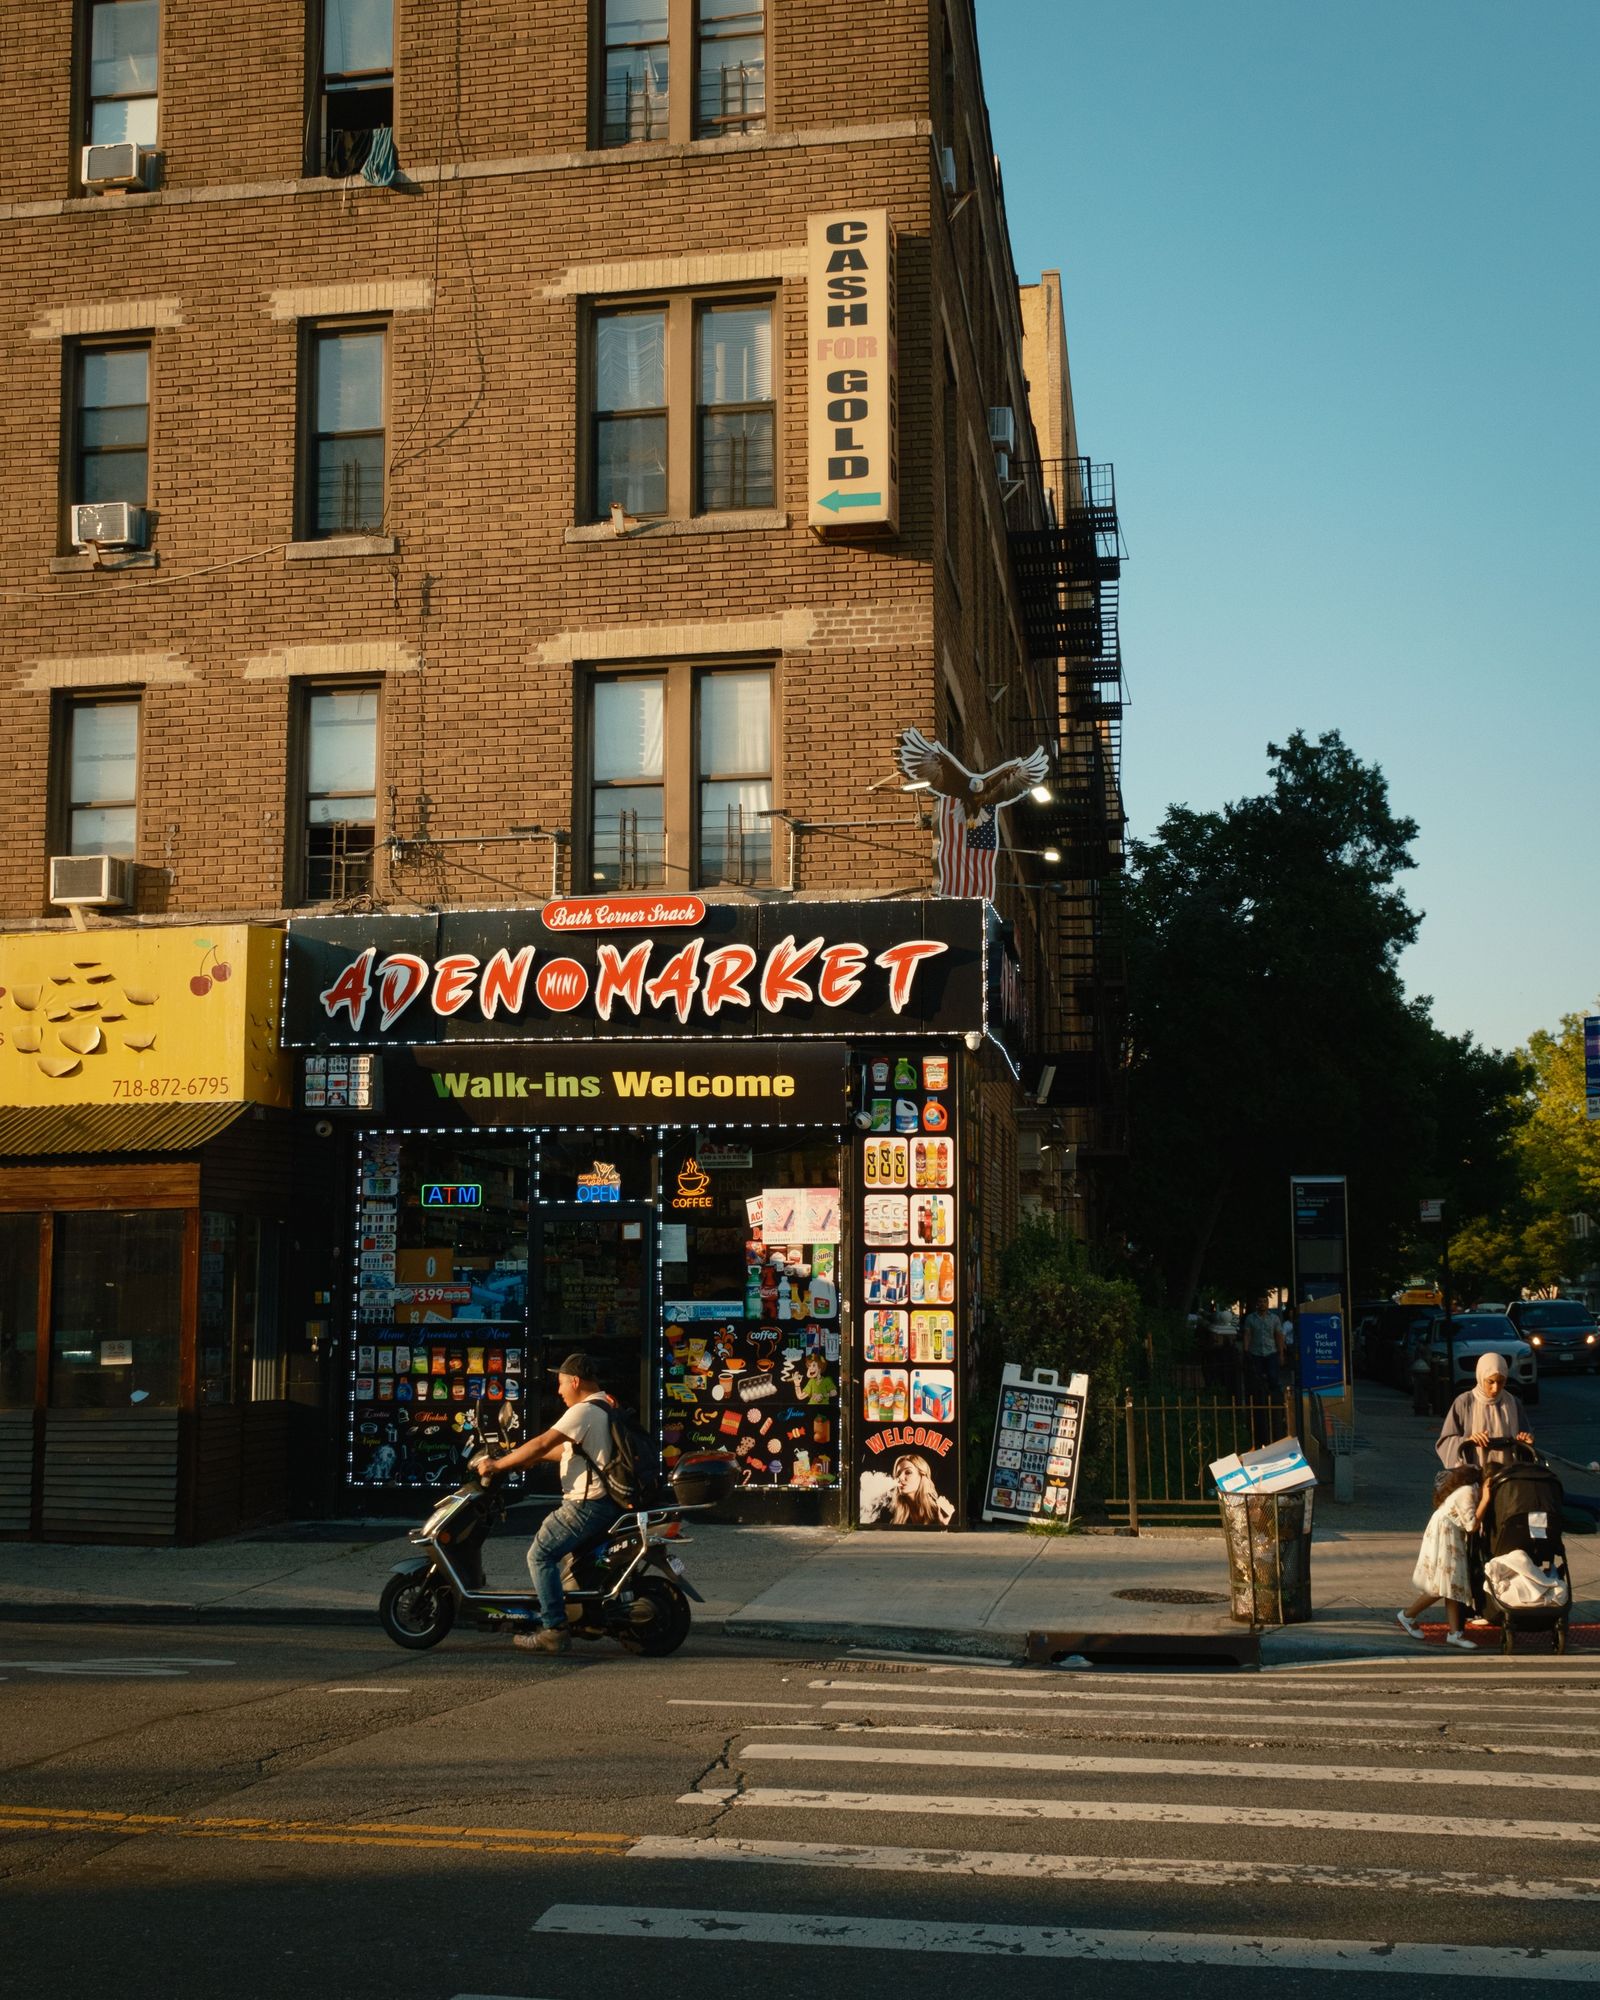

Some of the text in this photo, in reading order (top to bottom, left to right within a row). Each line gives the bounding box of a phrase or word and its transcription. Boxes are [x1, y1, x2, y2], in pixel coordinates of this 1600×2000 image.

[817, 221, 878, 481] CASH FOR GOLD
[549, 903, 696, 927] Bath Corner Snack
[320, 934, 949, 1033] ADEN MINI MARKET
[111, 1076, 230, 1098] 718-872-6795
[432, 1070, 796, 1099] Walk-ins Welcome
[867, 1152, 877, 1178] C4
[880, 1148, 891, 1177] C4
[895, 1152, 905, 1178] C4
[428, 1186, 476, 1204] ATM
[577, 1185, 620, 1202] OPEN
[672, 1196, 713, 1208] COFFEE
[750, 1330, 778, 1341] coffee
[1314, 1332, 1328, 1340] Get
[414, 1410, 449, 1423] Hookah
[865, 1425, 954, 1457] WELCOME
